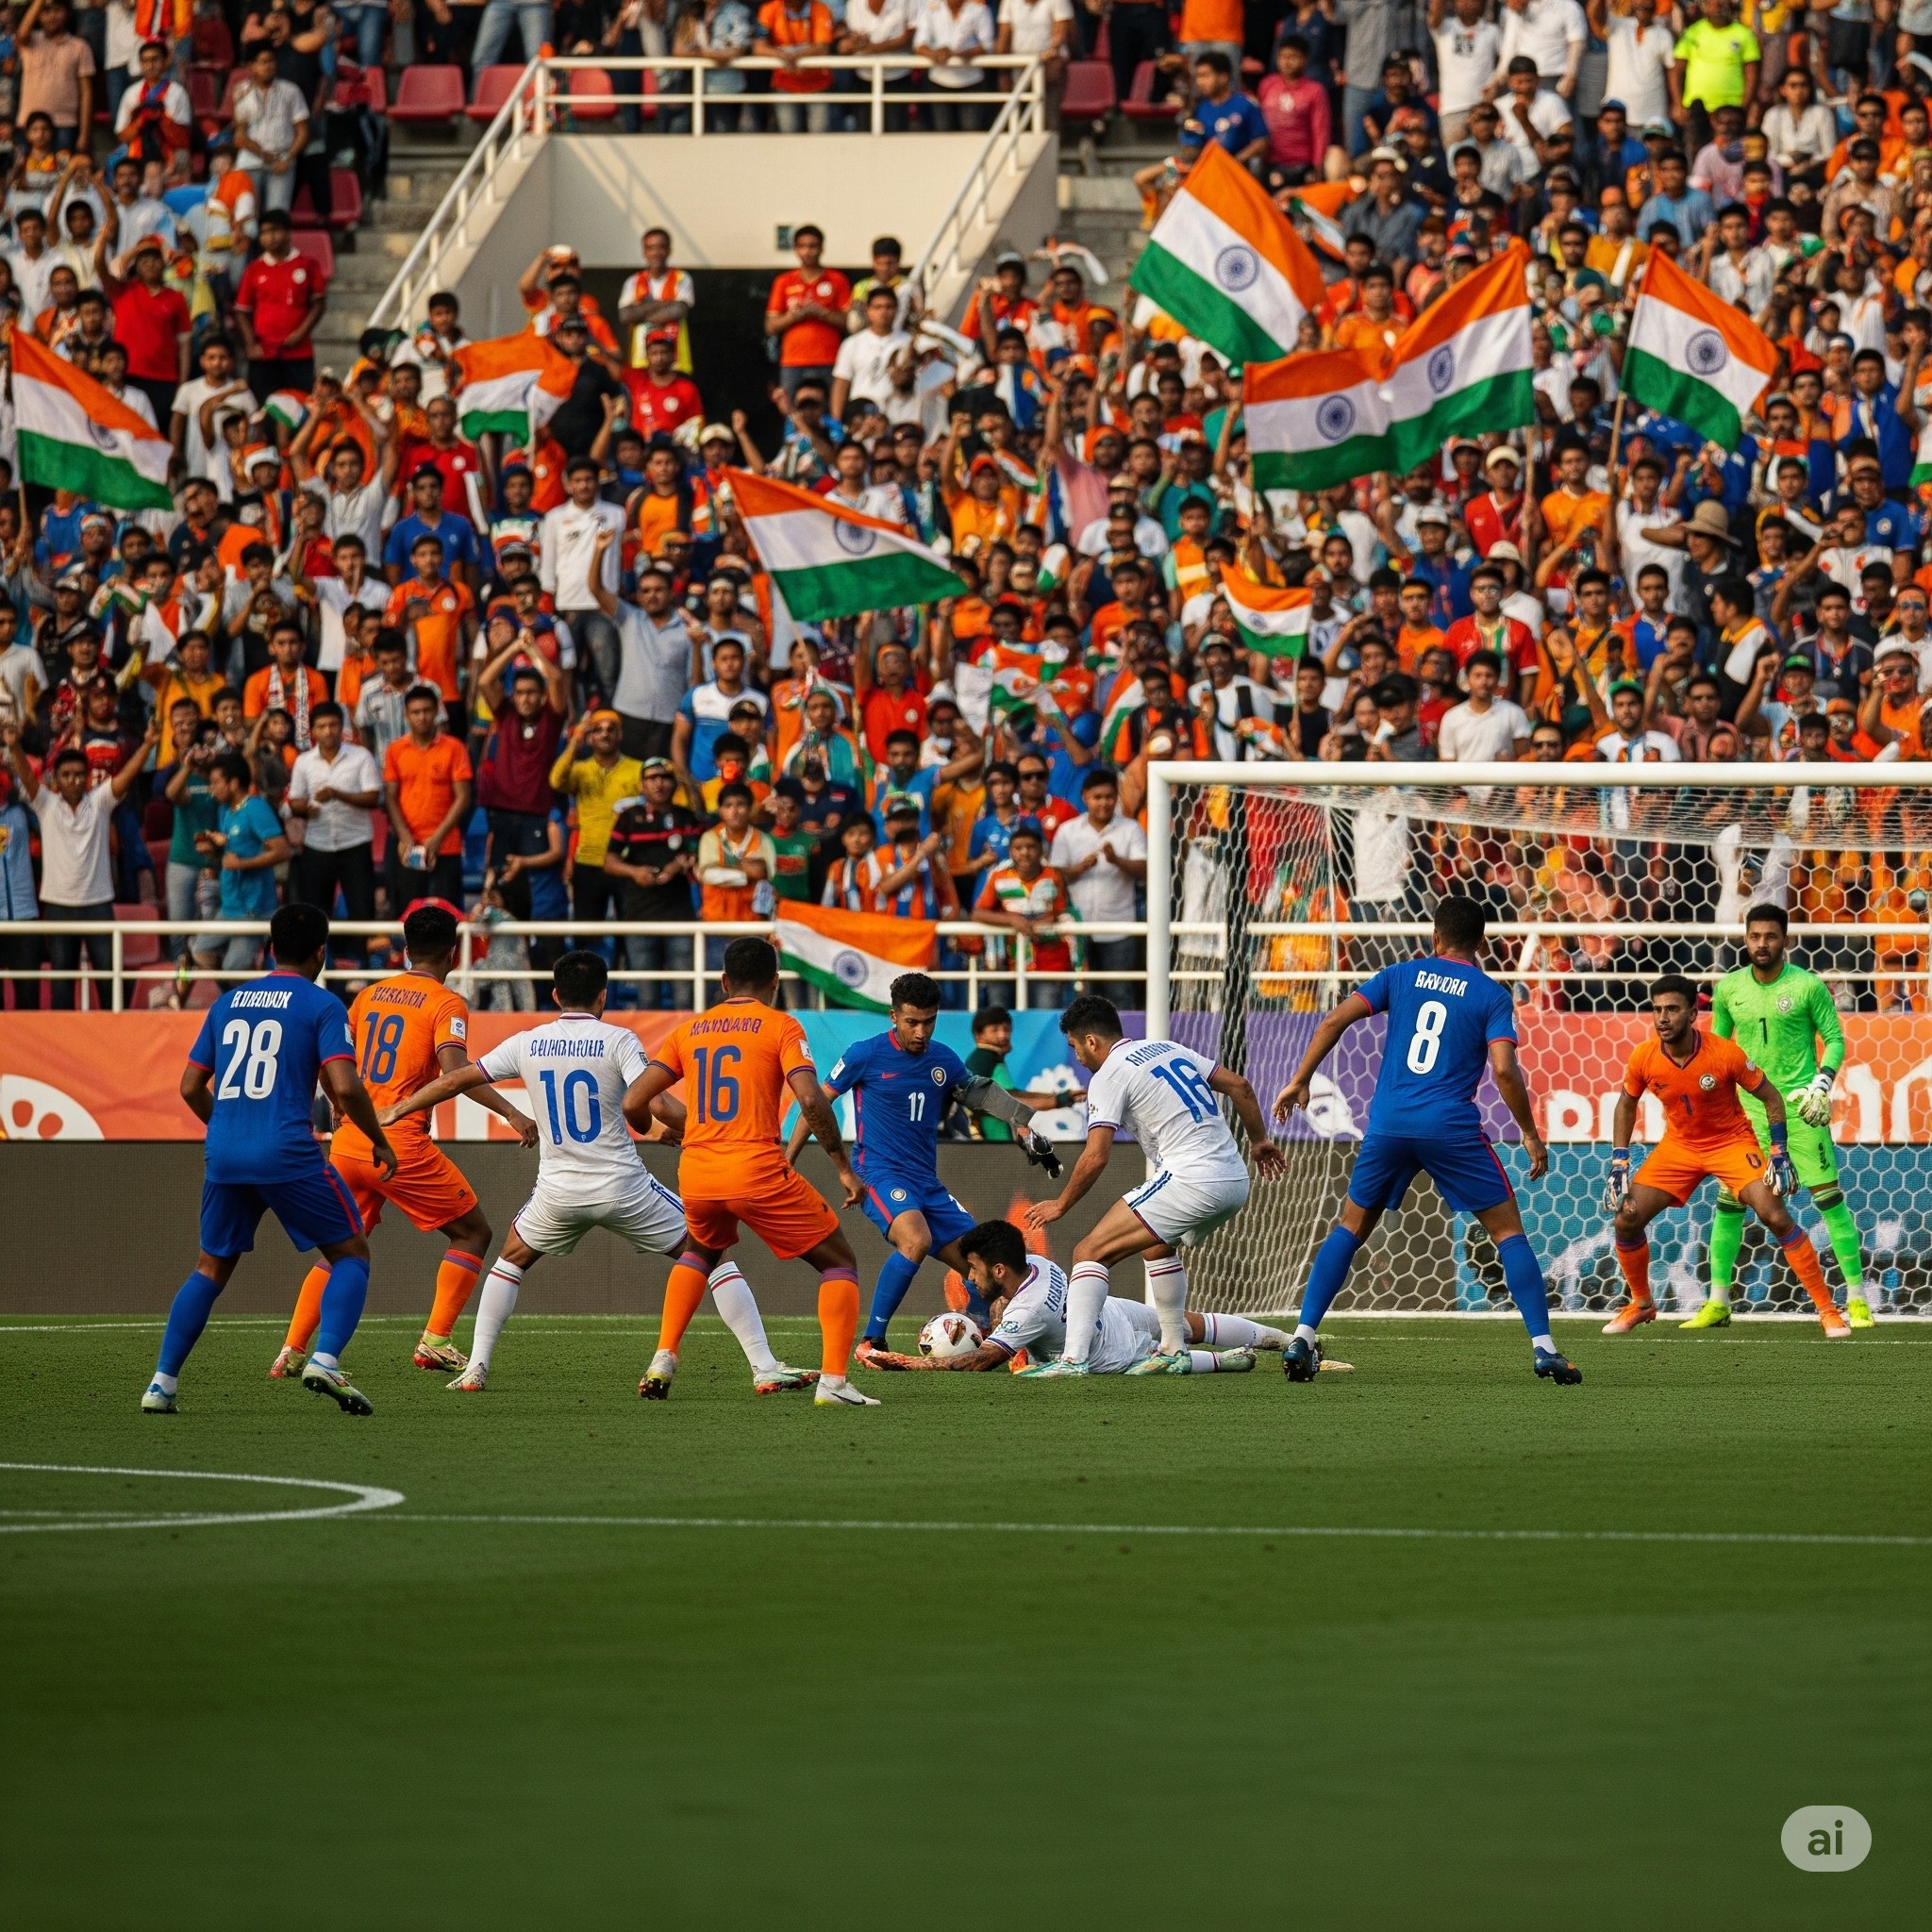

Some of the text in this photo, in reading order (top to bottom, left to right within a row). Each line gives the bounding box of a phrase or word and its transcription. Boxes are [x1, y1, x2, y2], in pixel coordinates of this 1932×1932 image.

[218, 1019, 282, 1100] 28
[360, 1011, 405, 1084] 18
[1407, 1000, 1447, 1074] 8
[1758, 1017, 1768, 1047] 1
[540, 1069, 602, 1145] 10
[693, 1044, 741, 1124] 16
[1680, 1093, 1692, 1116] 1
